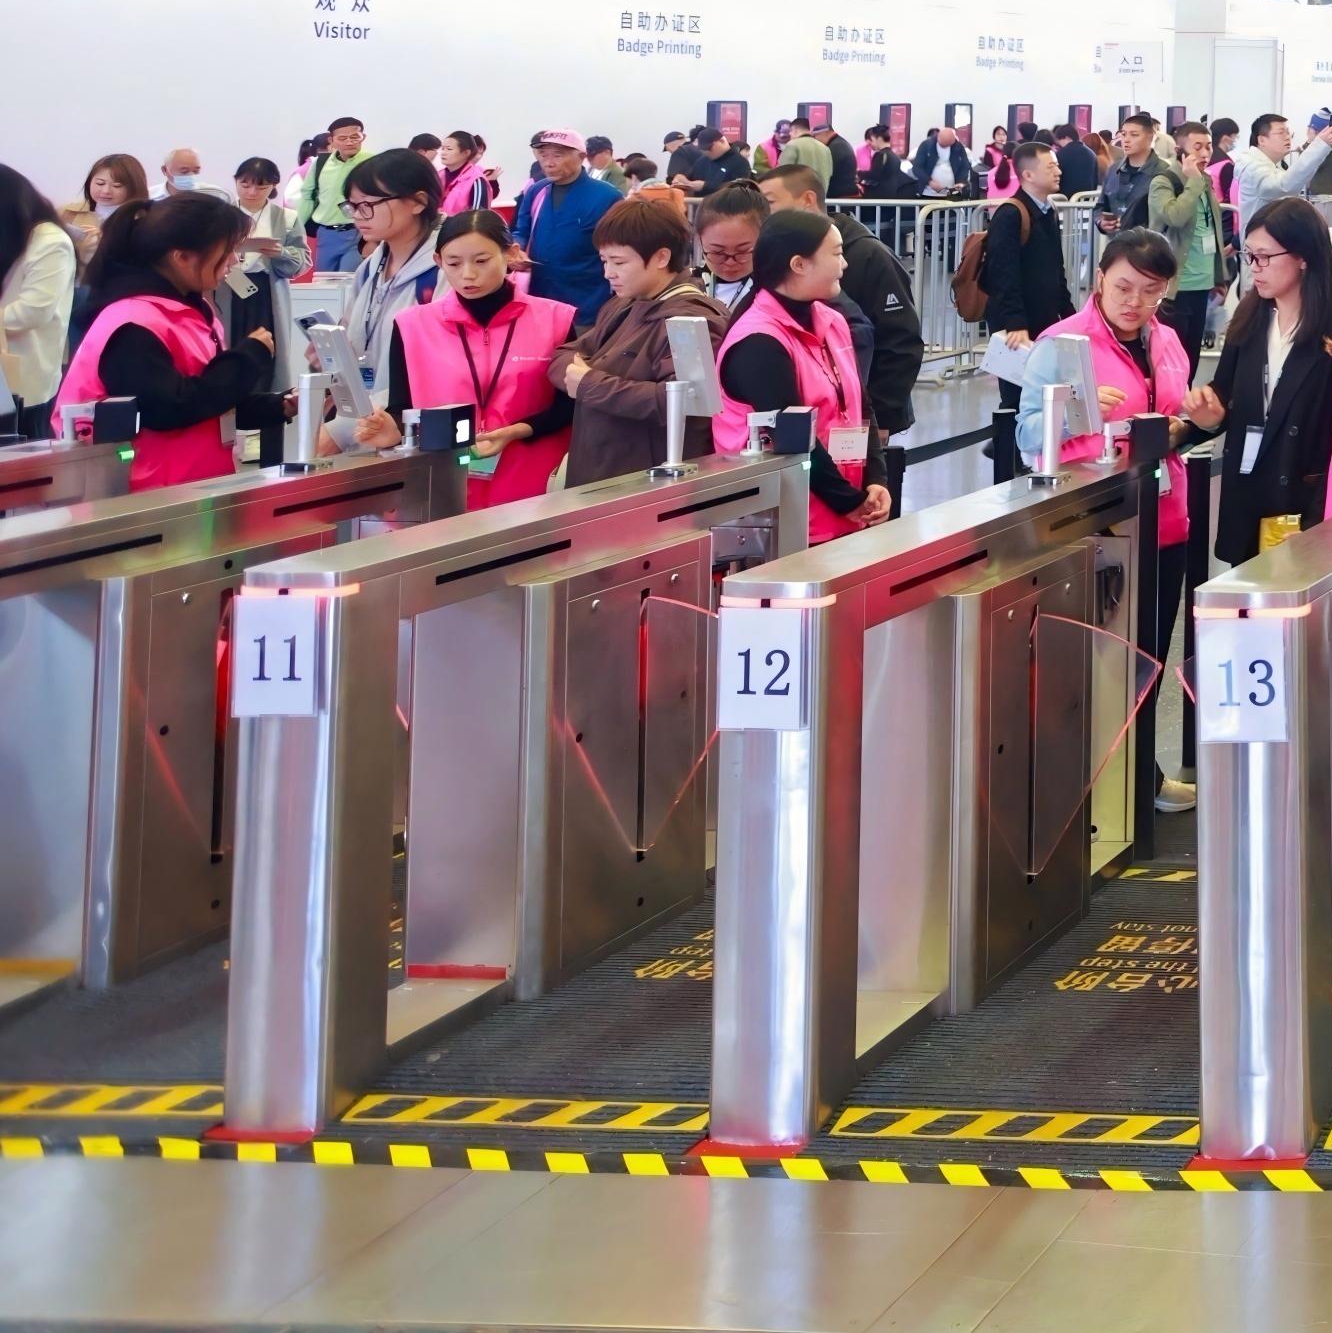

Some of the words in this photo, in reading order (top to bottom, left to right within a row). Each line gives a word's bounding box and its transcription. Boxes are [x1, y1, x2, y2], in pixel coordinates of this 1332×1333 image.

[313, 21, 370, 41] Visitor
[619, 10, 701, 33] 自助办证区
[824, 25, 886, 45] 自助办证区
[617, 38, 653, 56] Badge
[656, 40, 702, 59] Printing
[822, 48, 850, 64] Badge
[851, 50, 886, 66] Printing
[1119, 55, 1143, 65] 入口
[251, 635, 300, 682] 11
[736, 648, 791, 697] 12
[1216, 660, 1275, 707] 13
[1080, 957, 1131, 971] step
[1145, 957, 1189, 972] the
